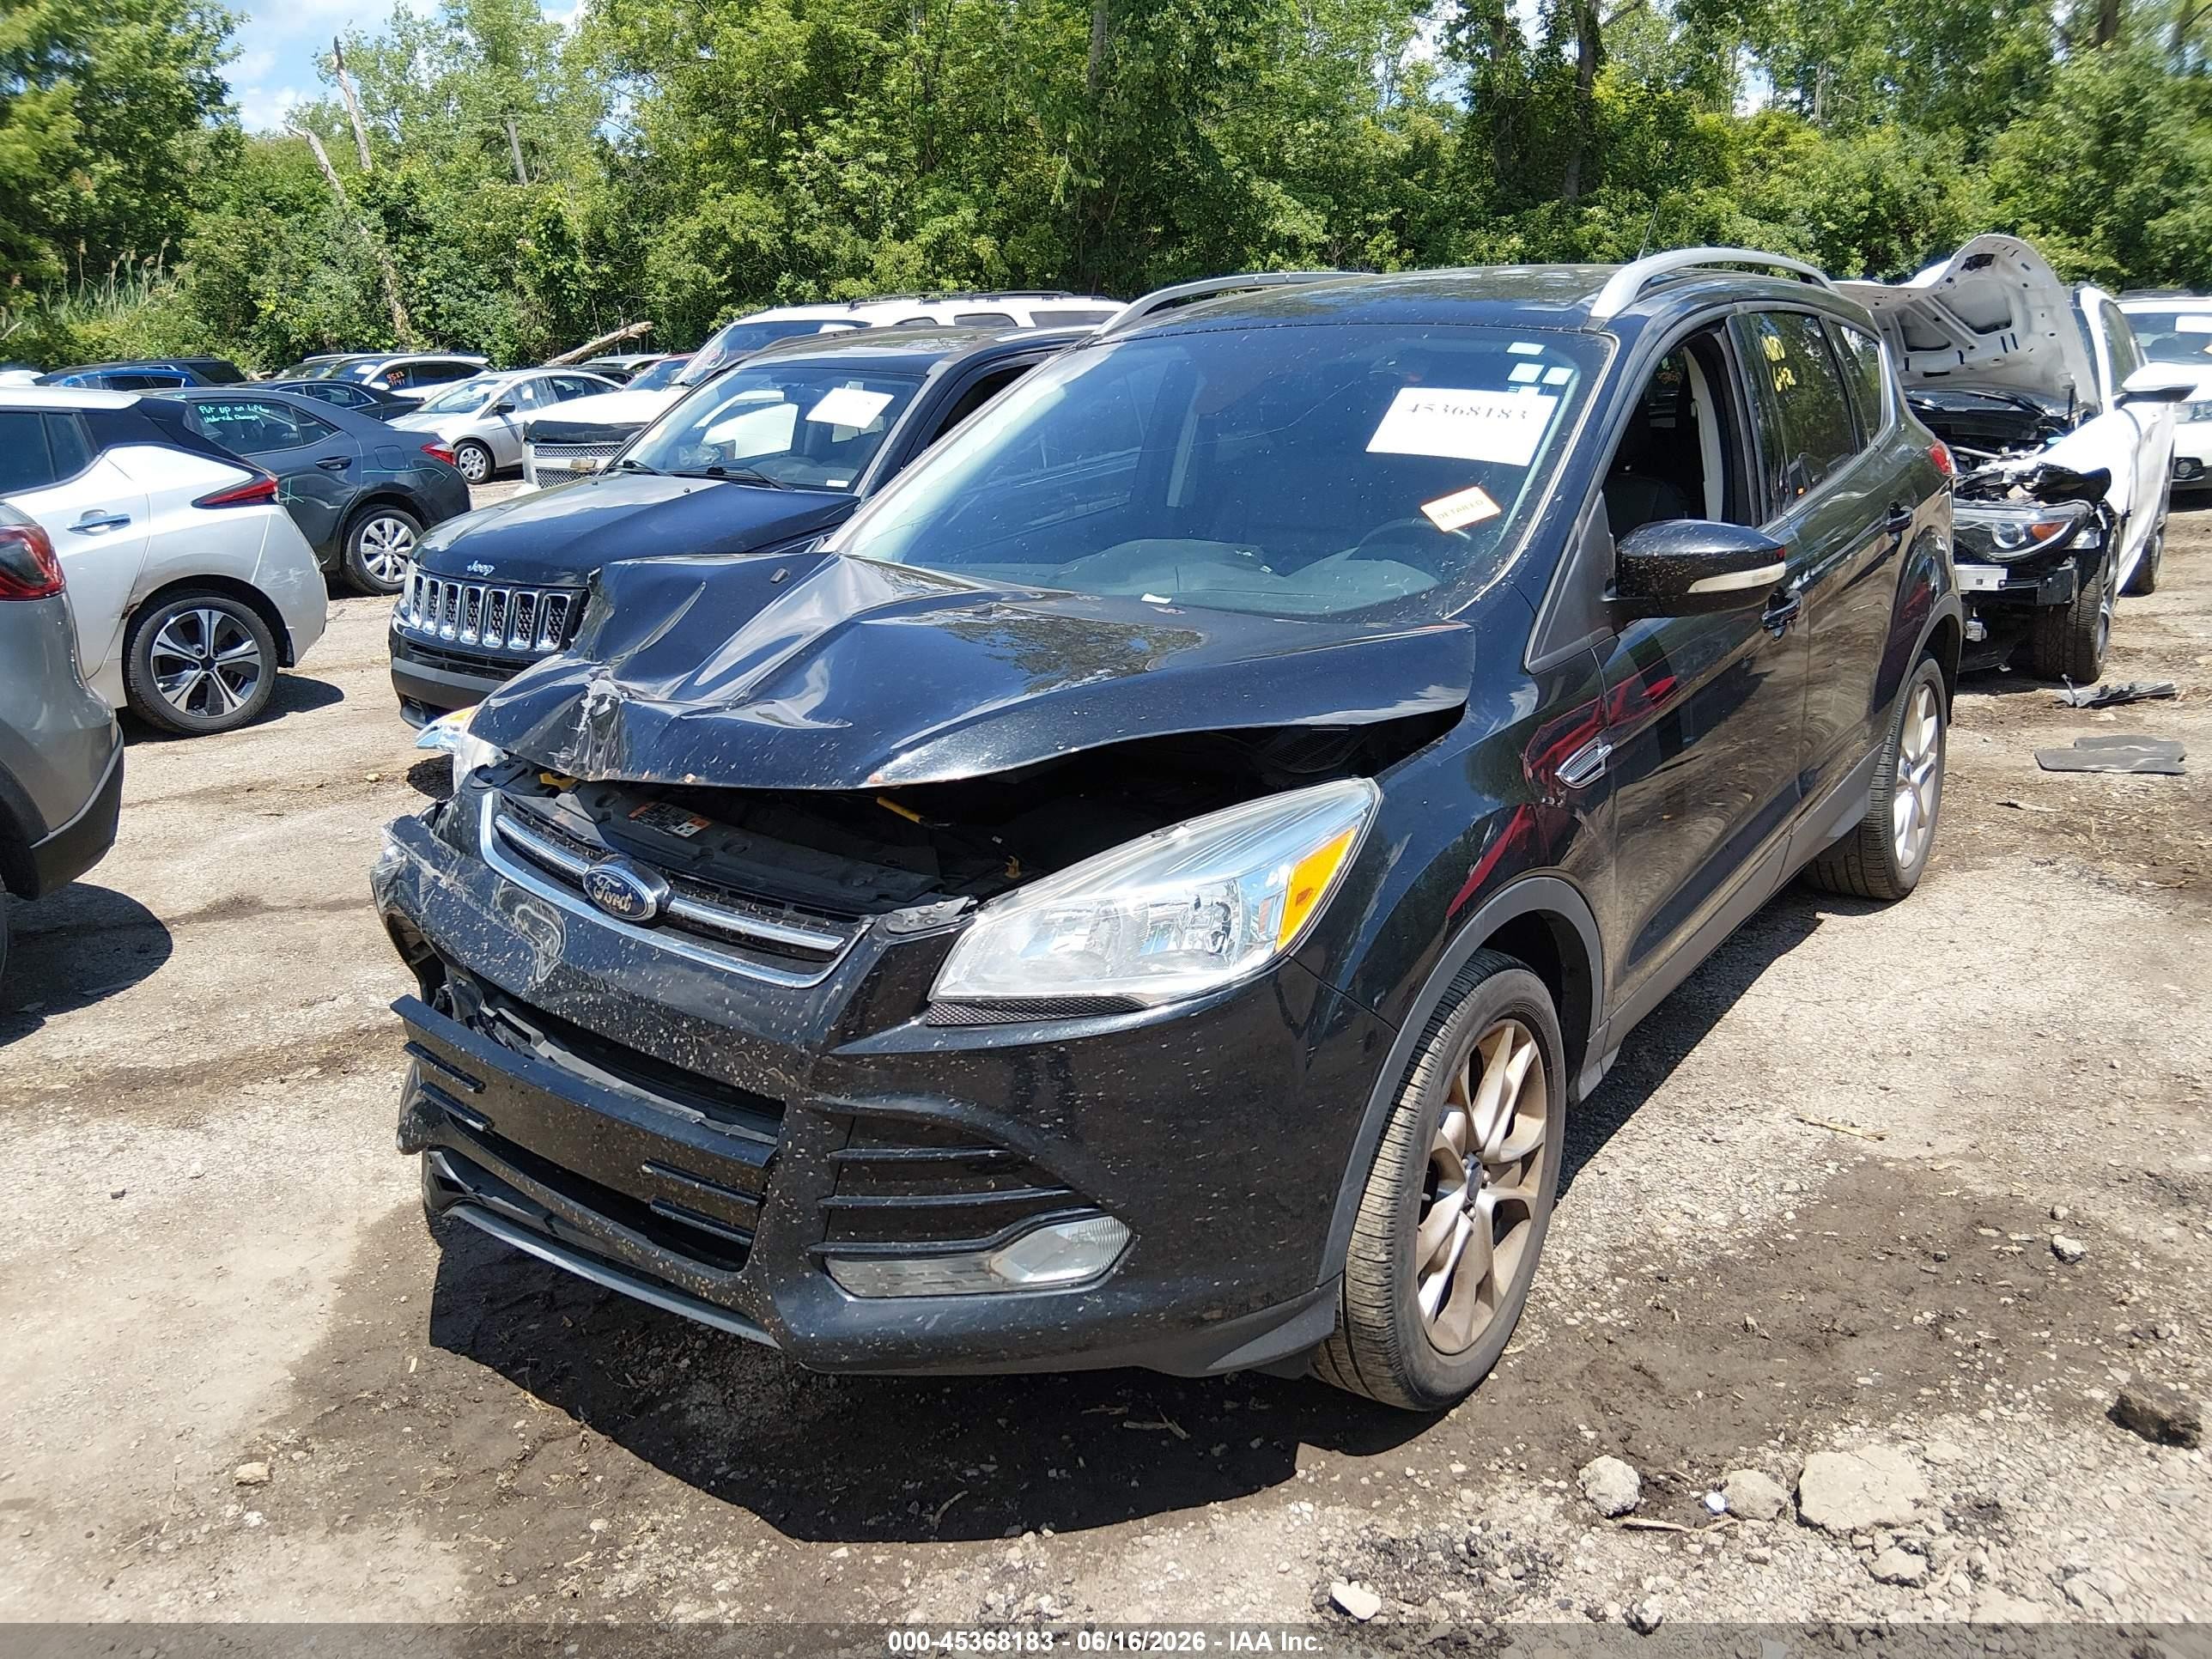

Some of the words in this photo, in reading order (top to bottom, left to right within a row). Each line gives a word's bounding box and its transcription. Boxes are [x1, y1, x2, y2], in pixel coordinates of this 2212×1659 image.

[198, 405, 216, 414] Put
[466, 559, 496, 576] Jeep
[592, 874, 633, 912] Ford
